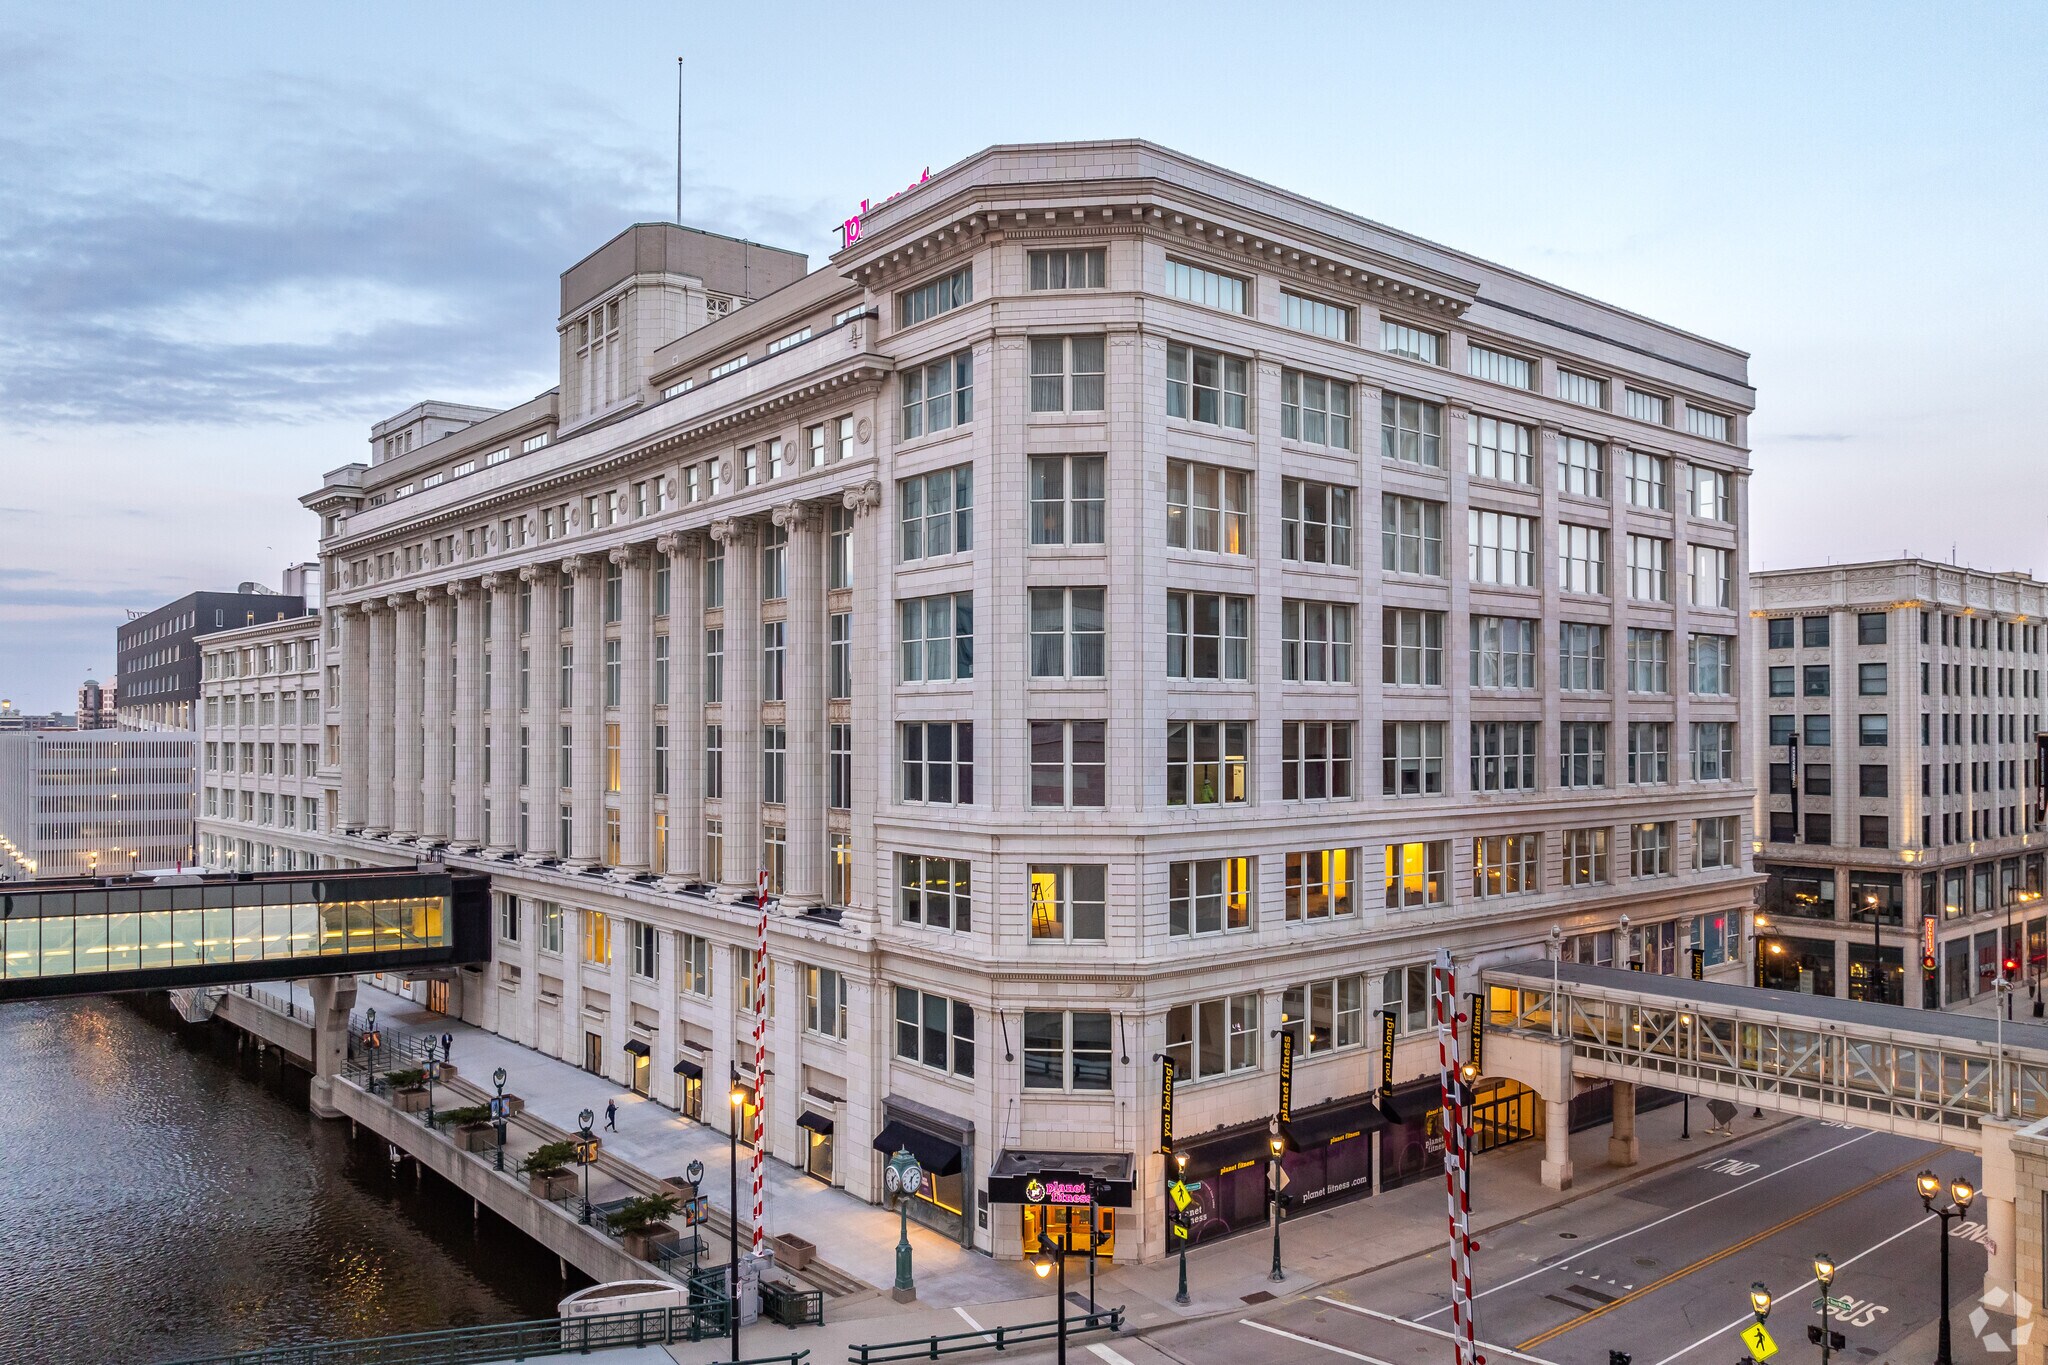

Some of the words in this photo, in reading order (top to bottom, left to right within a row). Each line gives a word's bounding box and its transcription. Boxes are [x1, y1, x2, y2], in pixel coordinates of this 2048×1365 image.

[1472, 997, 1482, 1035] fitness
[1384, 1017, 1395, 1060] belong!
[1281, 1035, 1291, 1079] fitness
[1163, 1062, 1174, 1111] belong!
[1280, 1081, 1291, 1123] planet
[1164, 1114, 1172, 1137] you
[1330, 1134, 1345, 1145] planet
[1345, 1130, 1360, 1140] fitness
[1425, 1135, 1445, 1149] planet
[1220, 1164, 1237, 1176] planet
[1237, 1159, 1255, 1169] fitness
[1697, 1157, 1761, 1176] ONLY
[1046, 1181, 1086, 1194] planet
[1302, 1187, 1326, 1204] planet
[1327, 1181, 1350, 1194] fitness
[1351, 1176, 1367, 1187] .com
